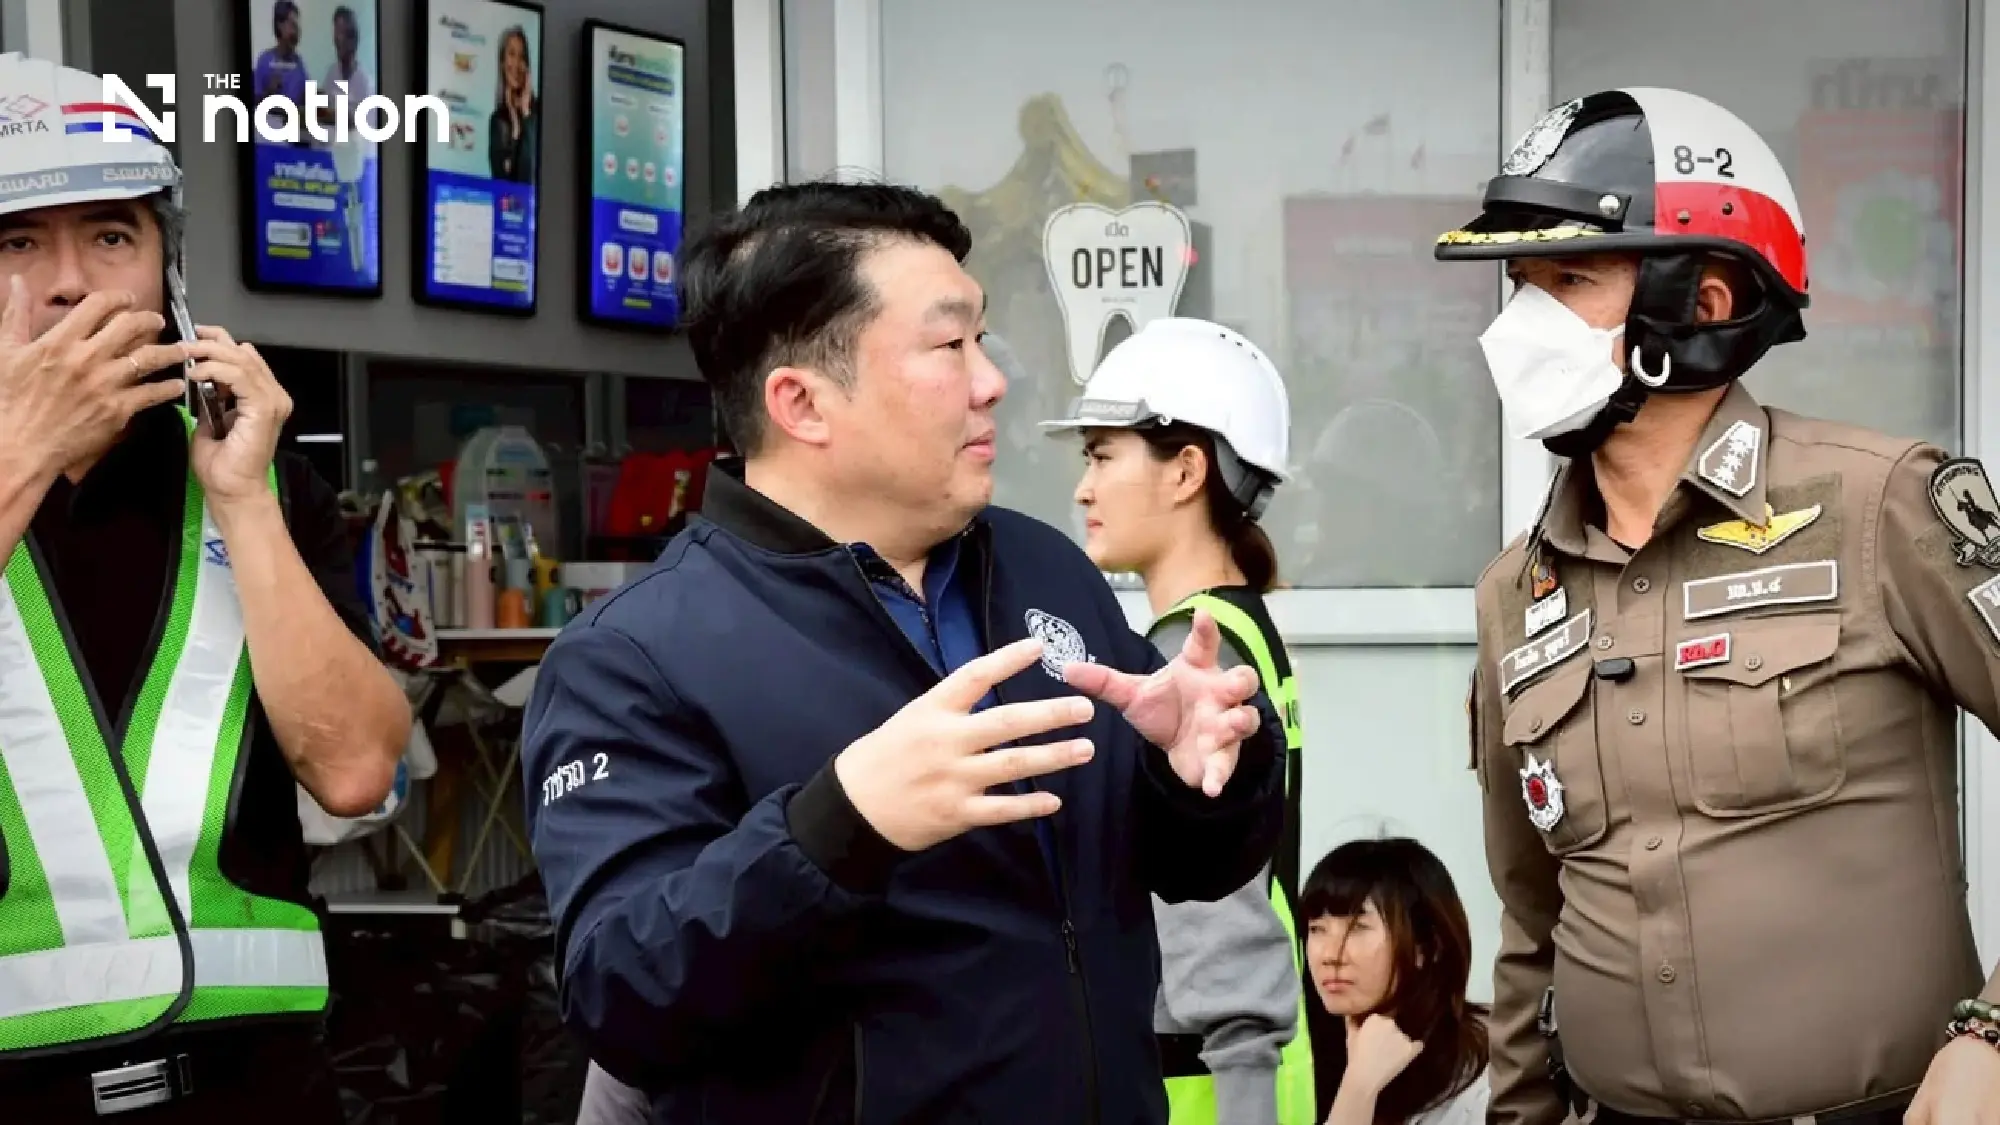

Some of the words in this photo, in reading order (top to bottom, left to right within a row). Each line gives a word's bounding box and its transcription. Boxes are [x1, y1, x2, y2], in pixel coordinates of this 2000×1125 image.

[1673, 145, 1735, 178] 8-2
[1072, 246, 1163, 289] OPEN
[592, 753, 609, 780] 2
